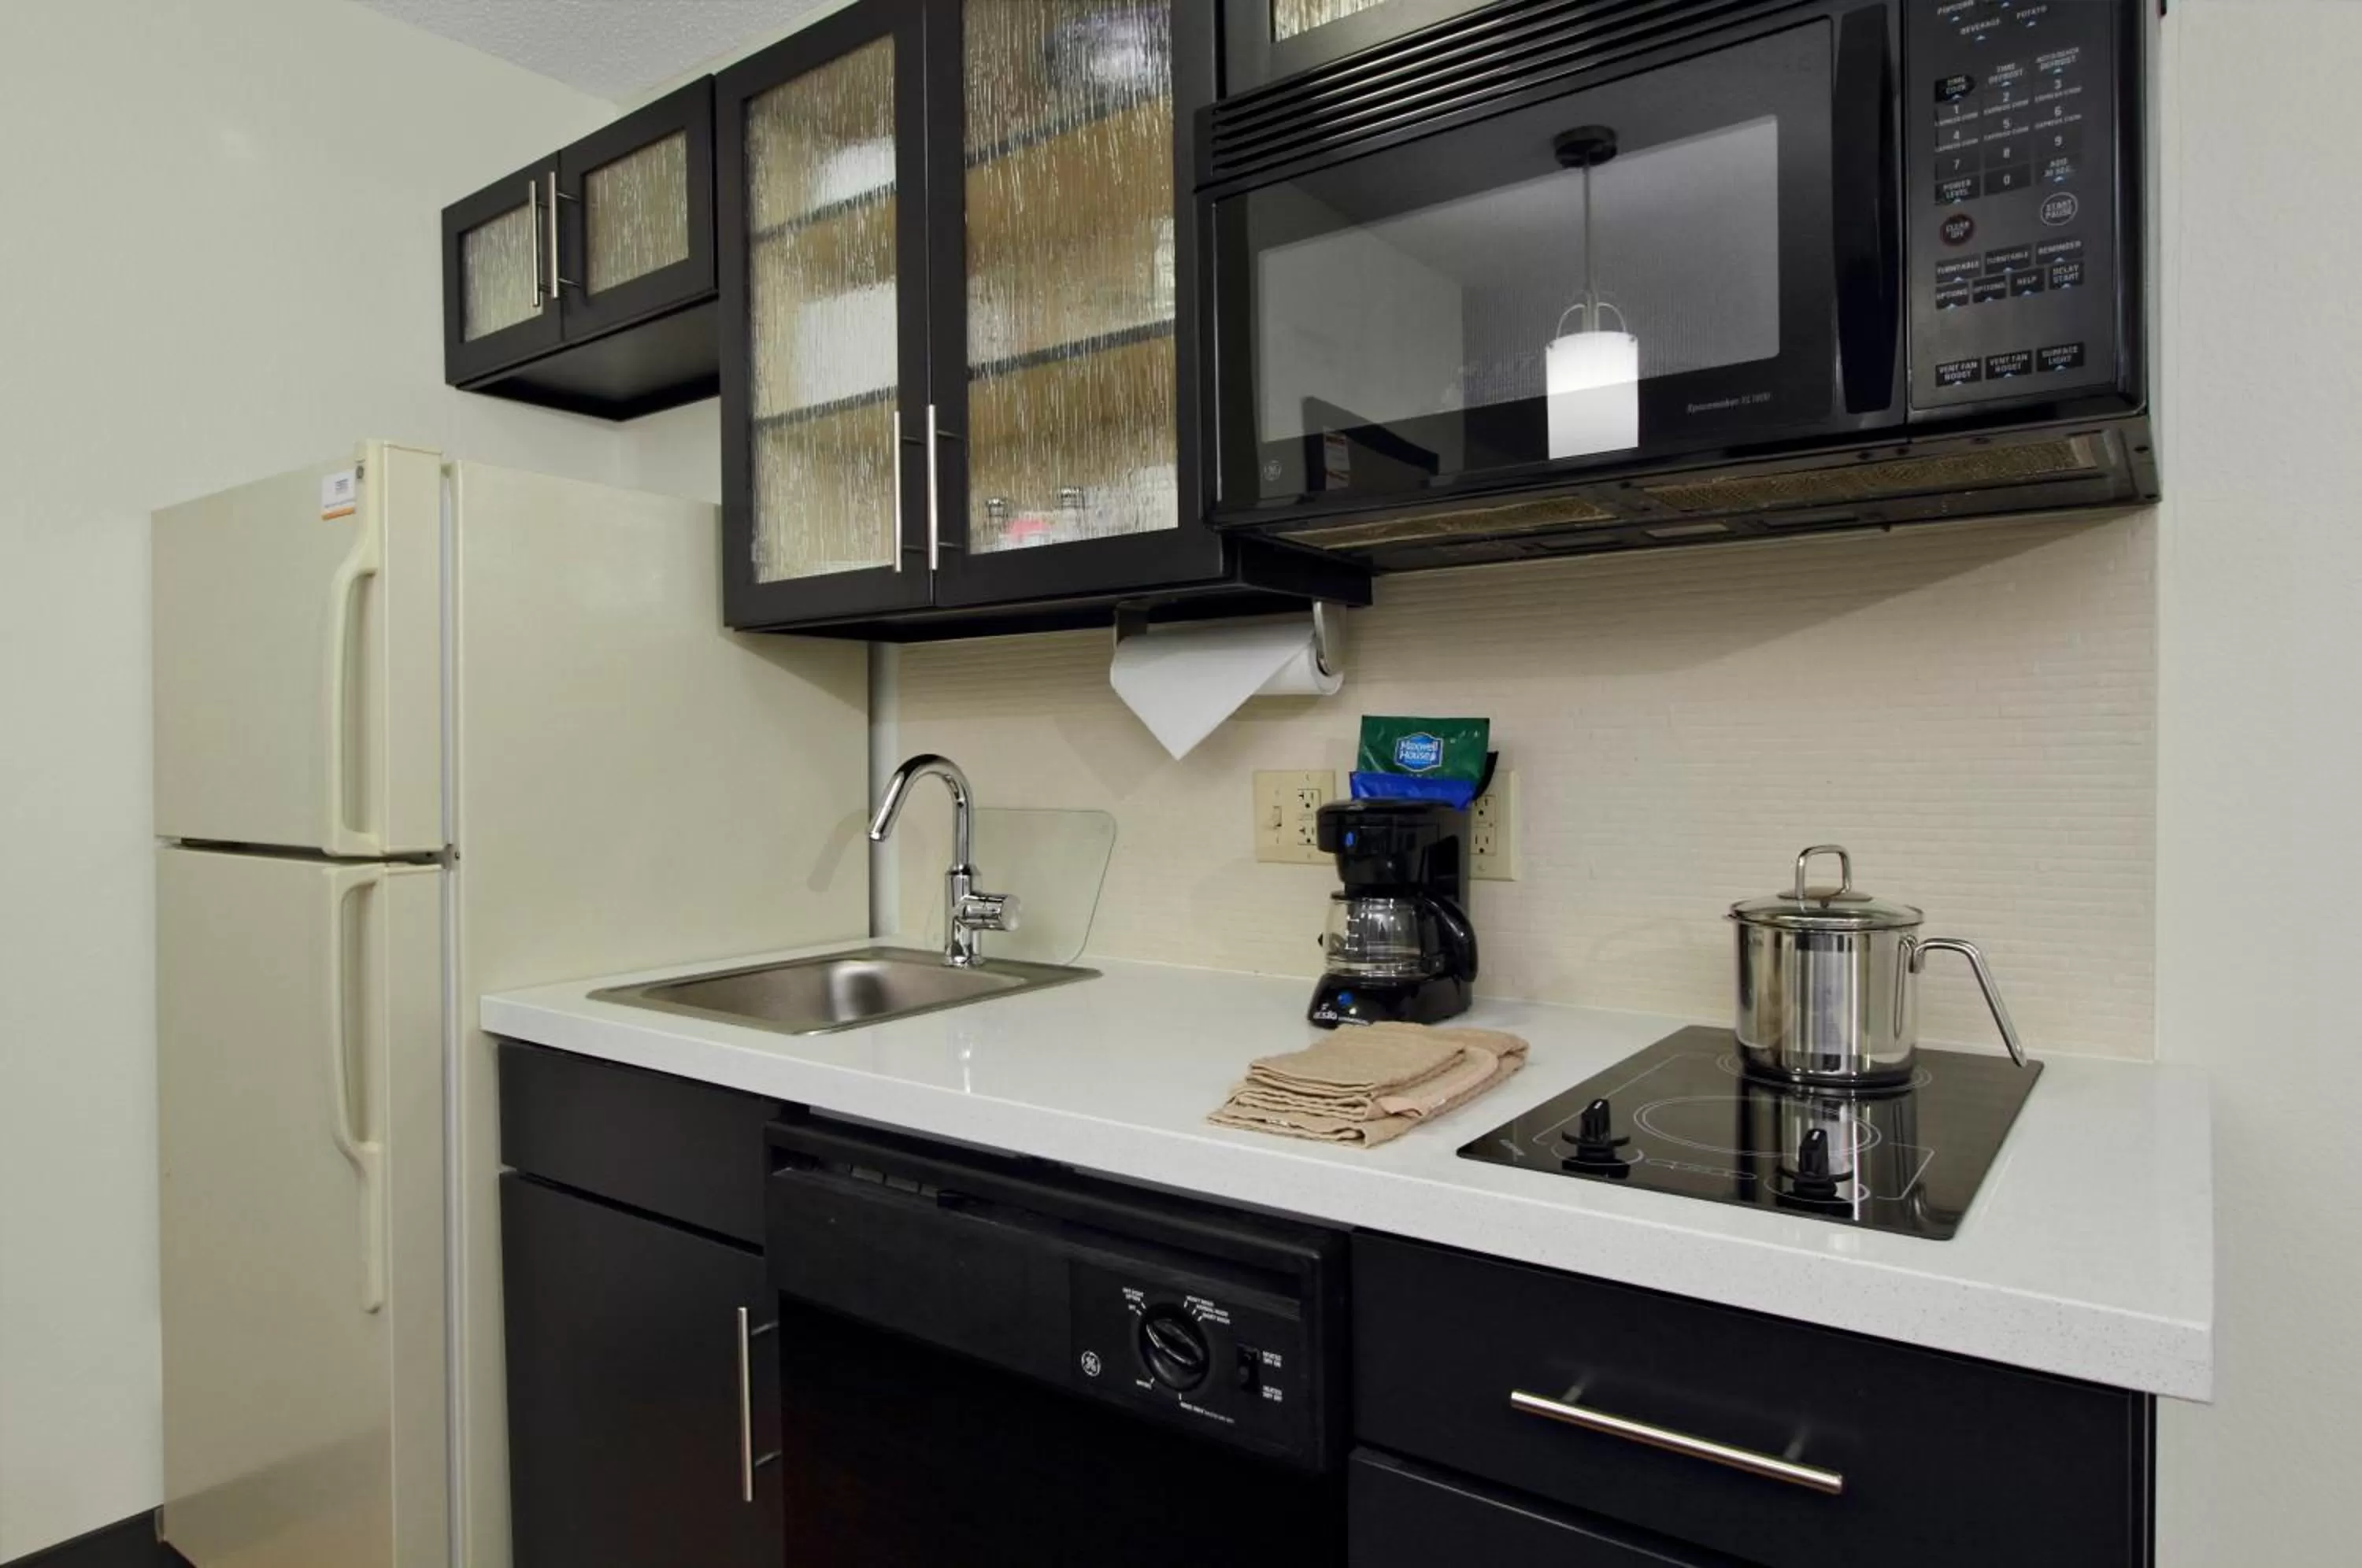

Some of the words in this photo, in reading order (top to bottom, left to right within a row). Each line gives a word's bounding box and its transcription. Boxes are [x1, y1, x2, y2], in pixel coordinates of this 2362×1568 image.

[2054, 79, 2062, 90] 3
[2002, 91, 2010, 102] 2
[2054, 105, 2062, 116] 6
[2002, 118, 2012, 130] 5
[1953, 129, 1960, 139] 4
[2054, 135, 2062, 146] 9
[2002, 146, 2011, 158] 8
[1953, 158, 1960, 170] 7
[2046, 199, 2072, 211] START
[2045, 207, 2072, 220] PAUSE
[1946, 220, 1970, 231] CLEAR
[2038, 240, 2082, 255] REMINDER
[2016, 276, 2038, 285] HELP
[2042, 345, 2079, 358] SURFACE
[1989, 355, 2008, 366] VENT
[2048, 355, 2072, 365] LIGHT
[1938, 364, 1958, 374] VENT
[1399, 740, 1438, 751] Maxwell
[1399, 750, 1436, 761] House
